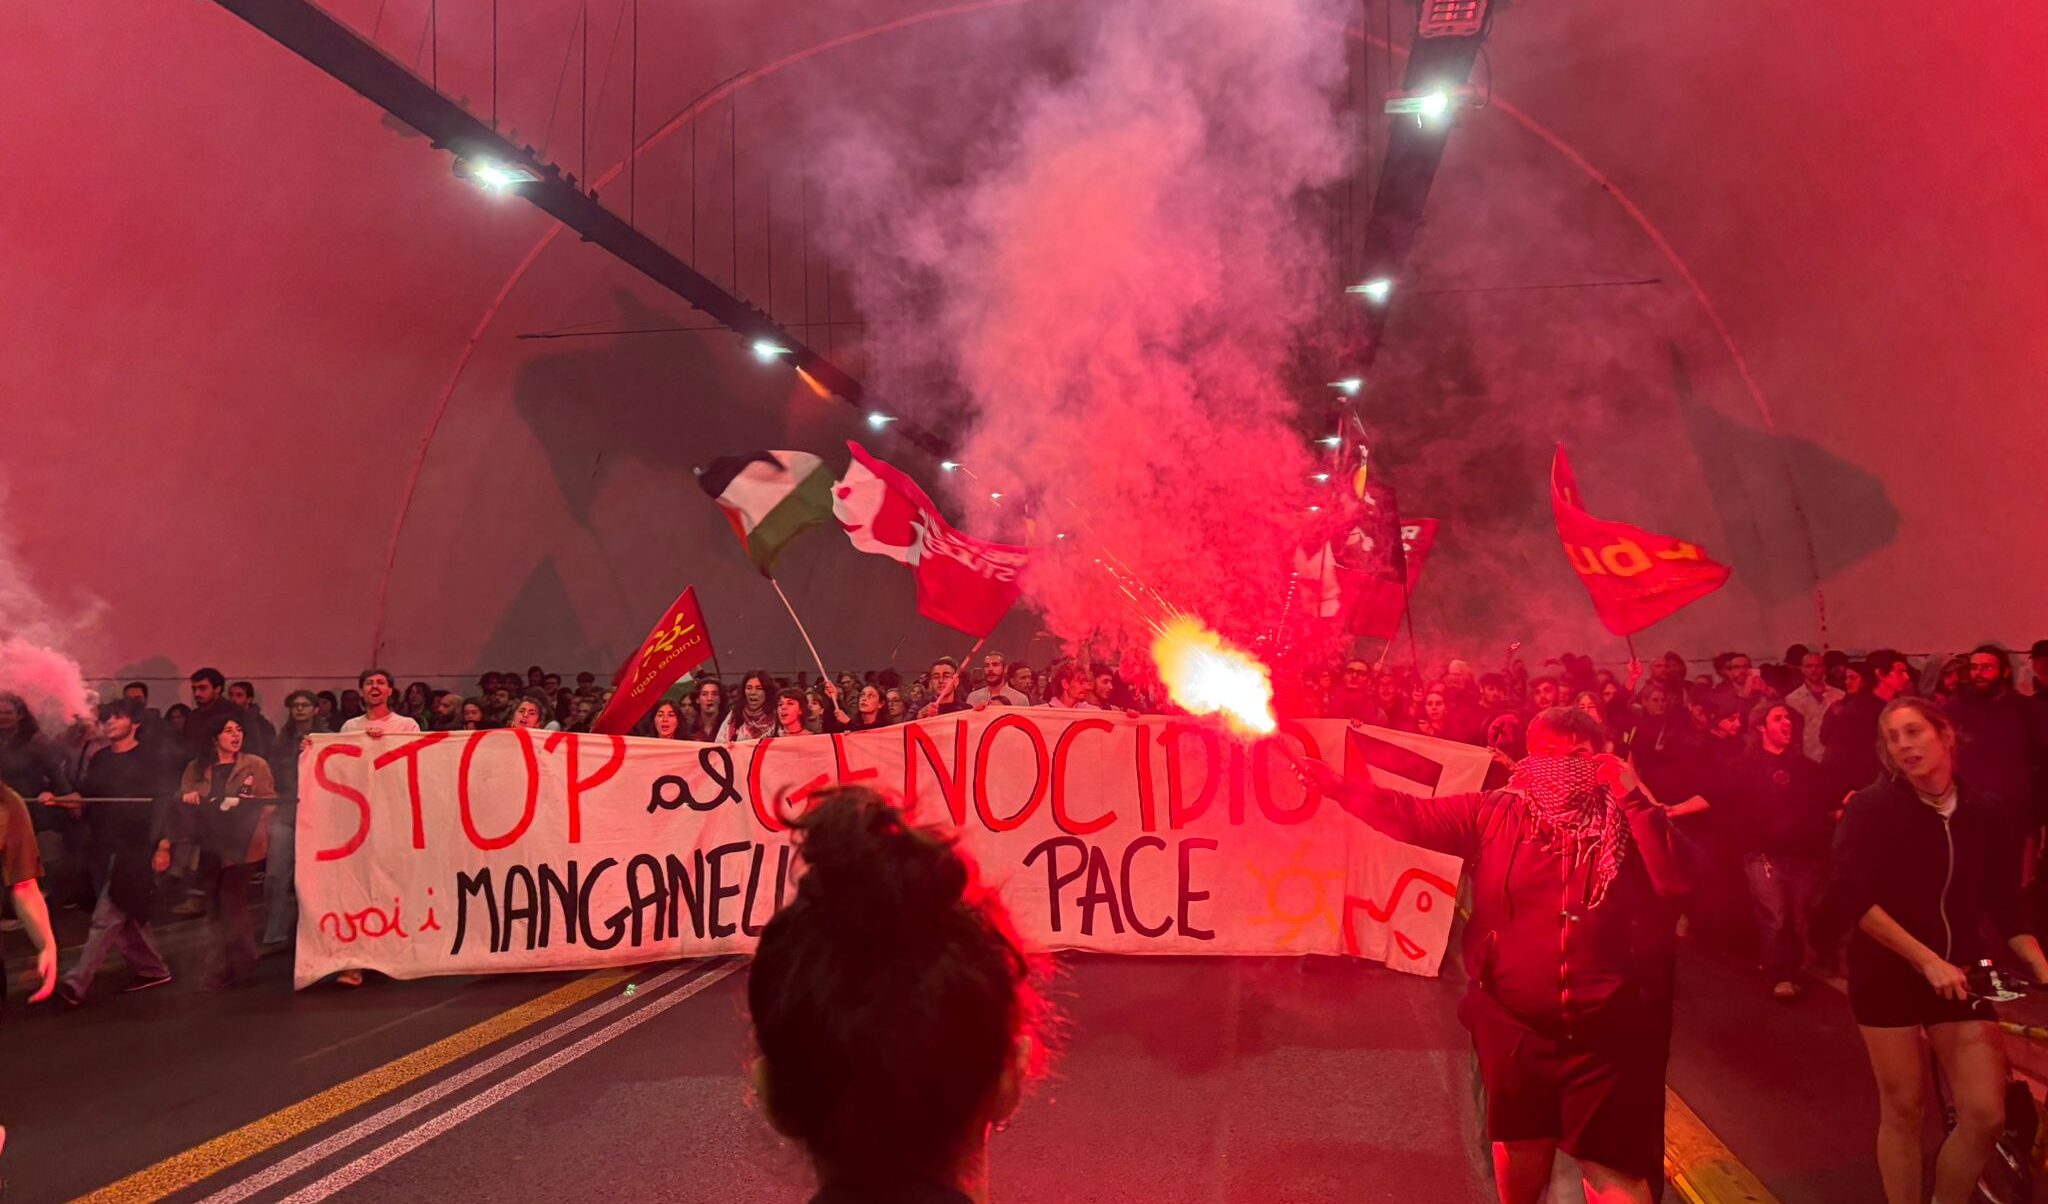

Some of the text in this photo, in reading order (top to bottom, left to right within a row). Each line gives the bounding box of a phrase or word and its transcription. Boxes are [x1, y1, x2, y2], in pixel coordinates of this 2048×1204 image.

[314, 728, 627, 862] STOP
[647, 746, 742, 814] al
[319, 896, 409, 943] voi
[418, 886, 442, 932] i
[1022, 836, 1219, 940] PACE
